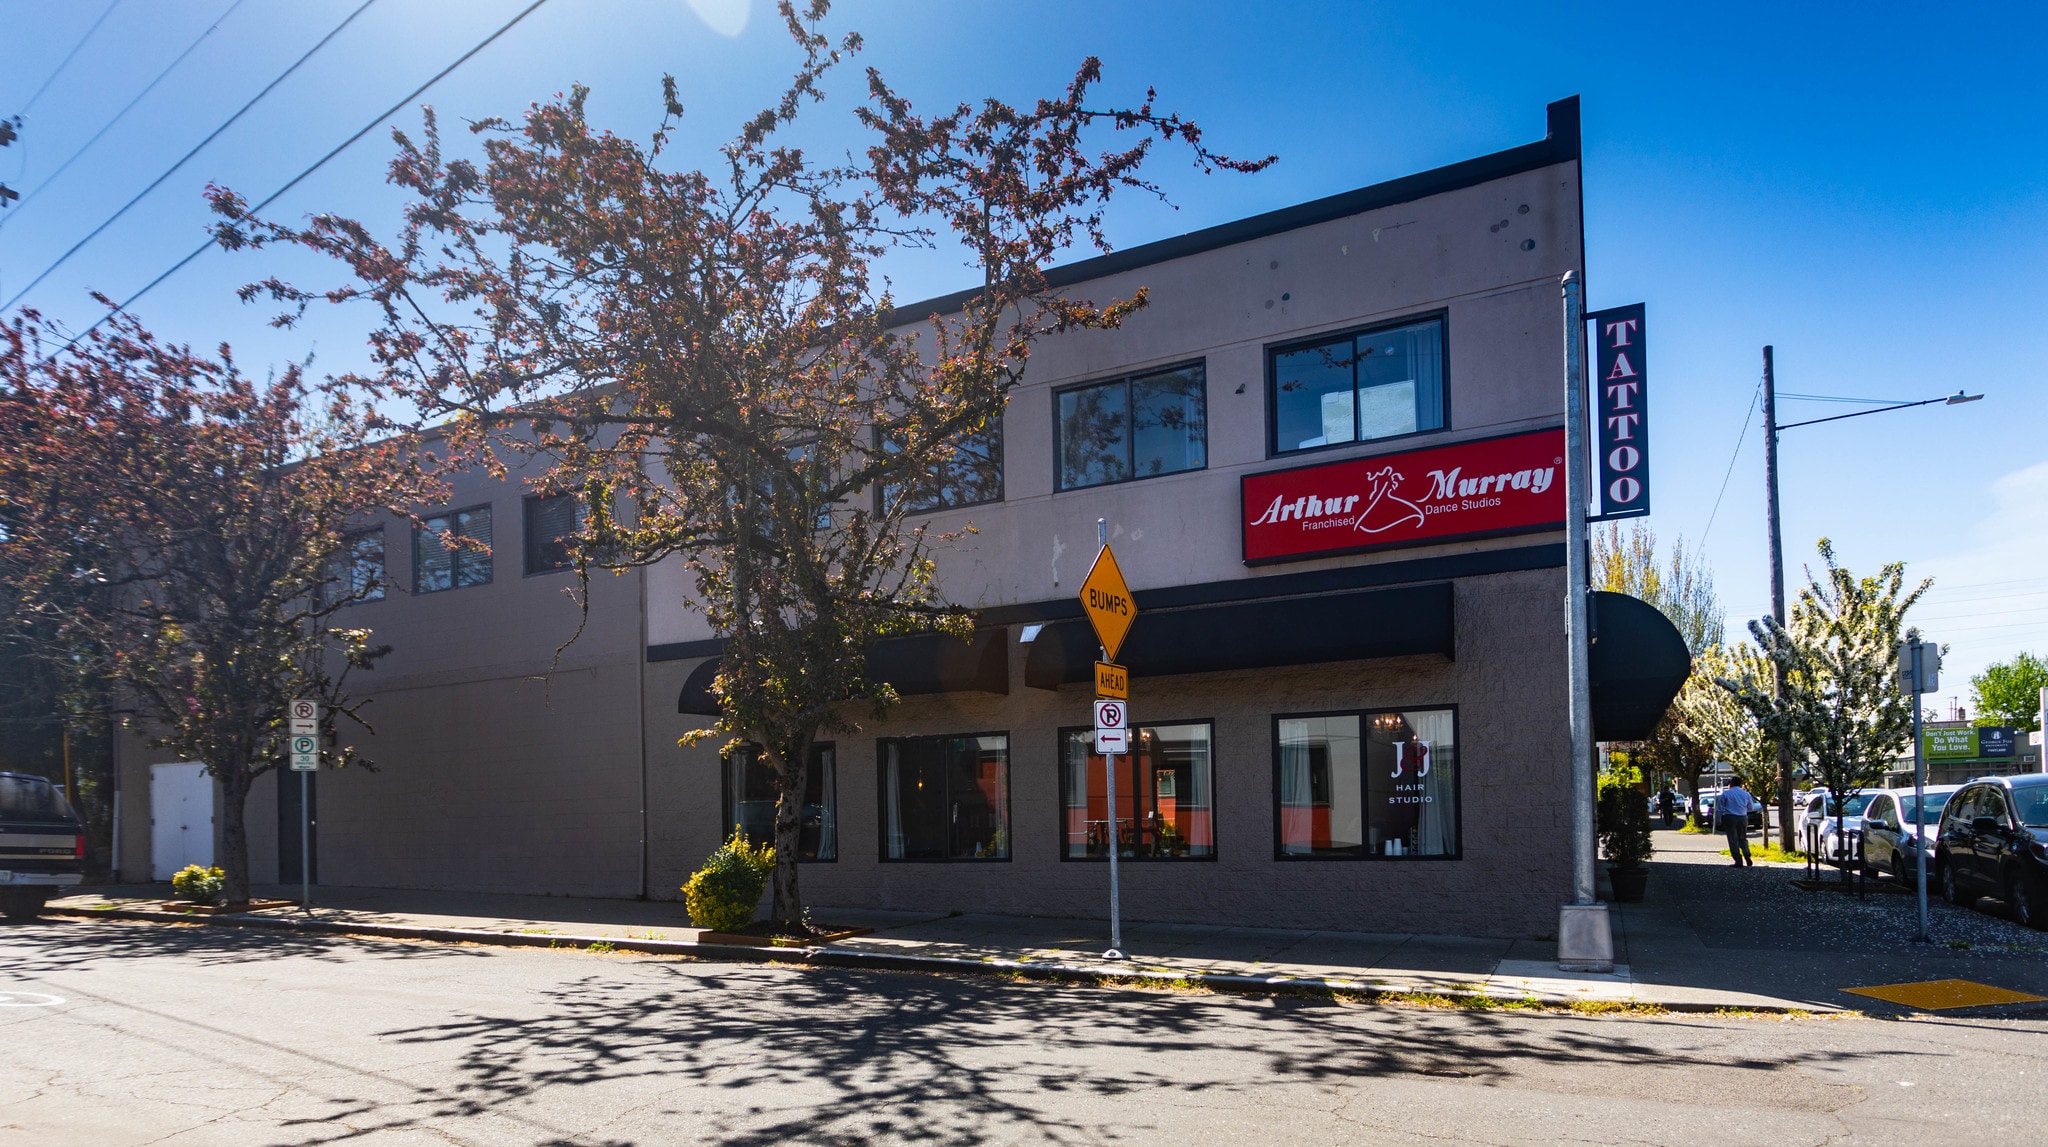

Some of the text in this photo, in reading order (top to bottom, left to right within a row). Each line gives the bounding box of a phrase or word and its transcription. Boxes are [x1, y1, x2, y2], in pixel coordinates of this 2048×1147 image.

[1606, 319, 1641, 503] TATTOO
[1250, 467, 1555, 525] Arthur Murray
[1425, 497, 1502, 516] Dance Studios
[1302, 515, 1355, 531] Franchised
[1089, 588, 1128, 616] BUMPS
[1100, 671, 1125, 692] AHEAD
[300, 740, 310, 750] P
[1396, 784, 1425, 792] HAIR
[1388, 796, 1433, 804] STUDIO
